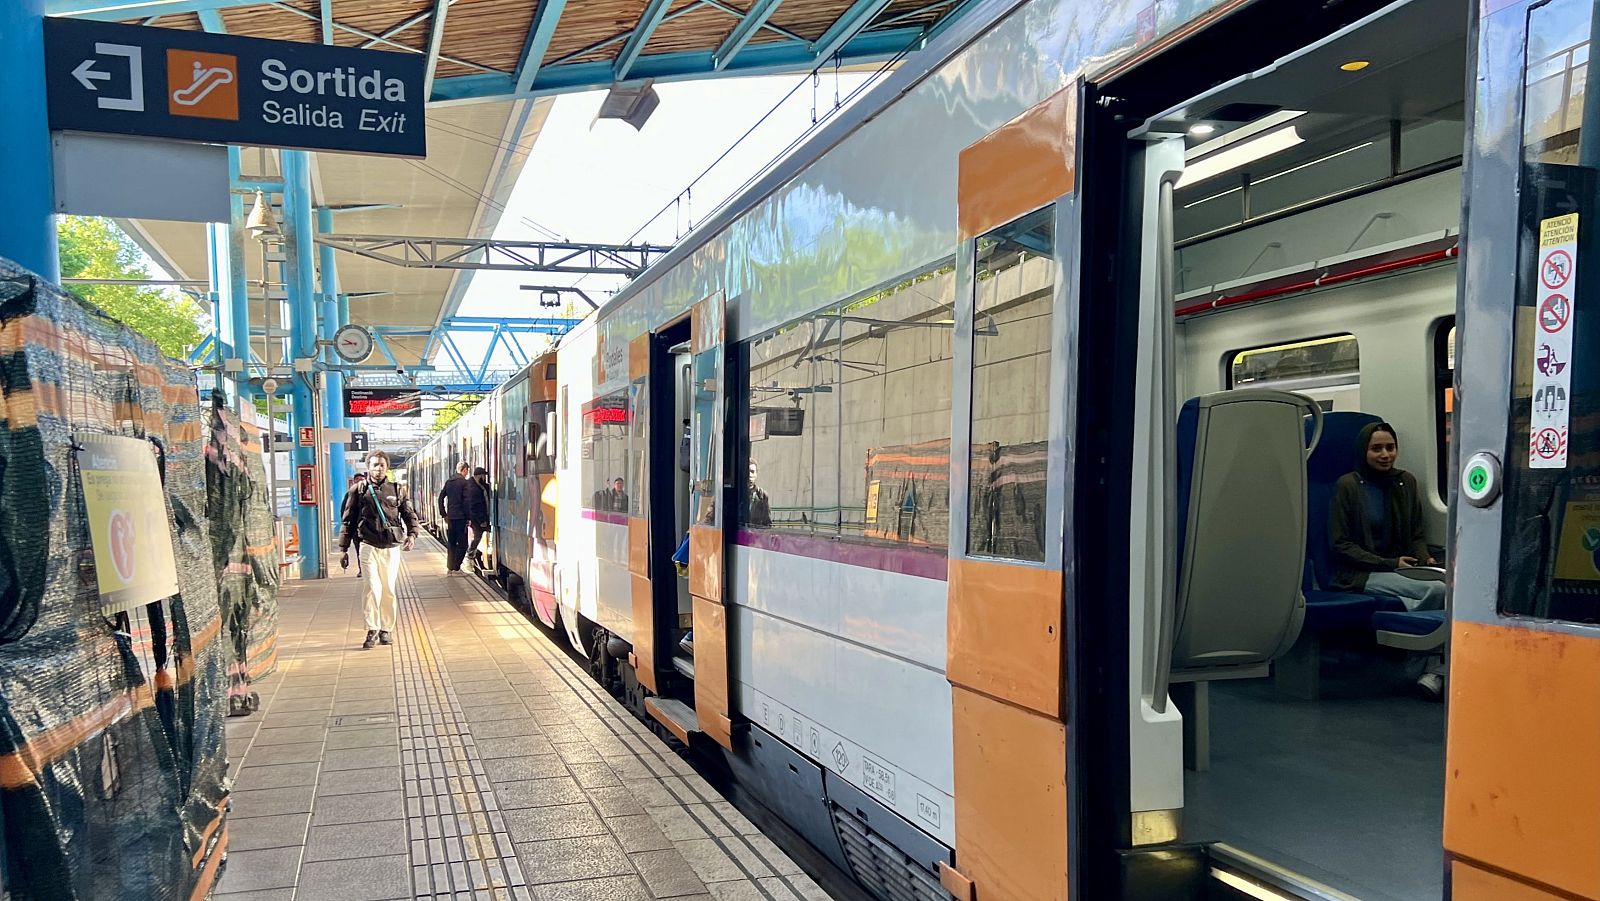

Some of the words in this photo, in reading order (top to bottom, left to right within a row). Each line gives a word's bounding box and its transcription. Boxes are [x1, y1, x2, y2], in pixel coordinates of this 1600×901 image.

[261, 58, 406, 102] Sortida
[262, 100, 344, 129] Salida
[358, 108, 407, 133] Exit
[1542, 234, 1575, 246] ATTENTION
[355, 440, 363, 450] 1
